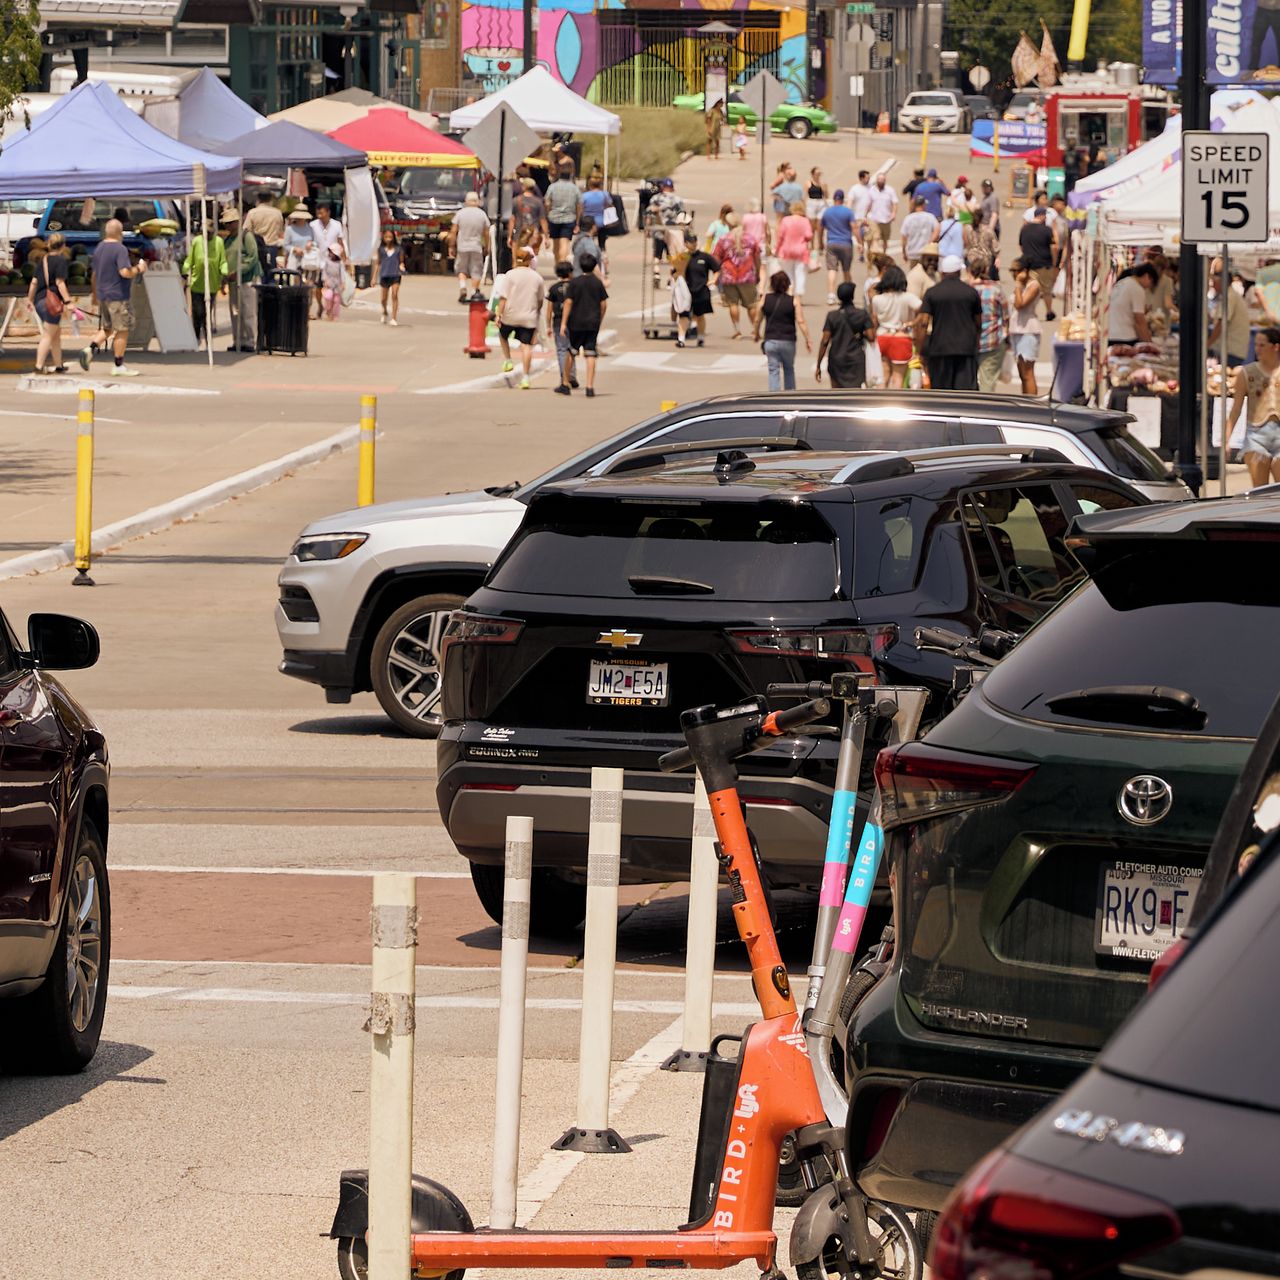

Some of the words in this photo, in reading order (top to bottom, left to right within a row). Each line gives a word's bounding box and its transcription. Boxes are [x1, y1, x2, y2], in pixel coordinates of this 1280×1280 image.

[1151, 30, 1172, 44] A
[1190, 146, 1262, 163] SPEED
[1198, 168, 1253, 185] LIMIT
[1201, 190, 1250, 229] 15
[610, 697, 643, 706] TIGERS
[854, 840, 876, 888] BIRD
[1115, 861, 1156, 875] FLETCHER
[1157, 866, 1179, 876] AUTO
[1149, 874, 1185, 884] MISSOURI
[1106, 886, 1157, 935] RK9
[921, 1003, 1028, 1029] HIGHLANDER
[714, 1139, 747, 1228] BIRD
[734, 1083, 760, 1119] lyft
